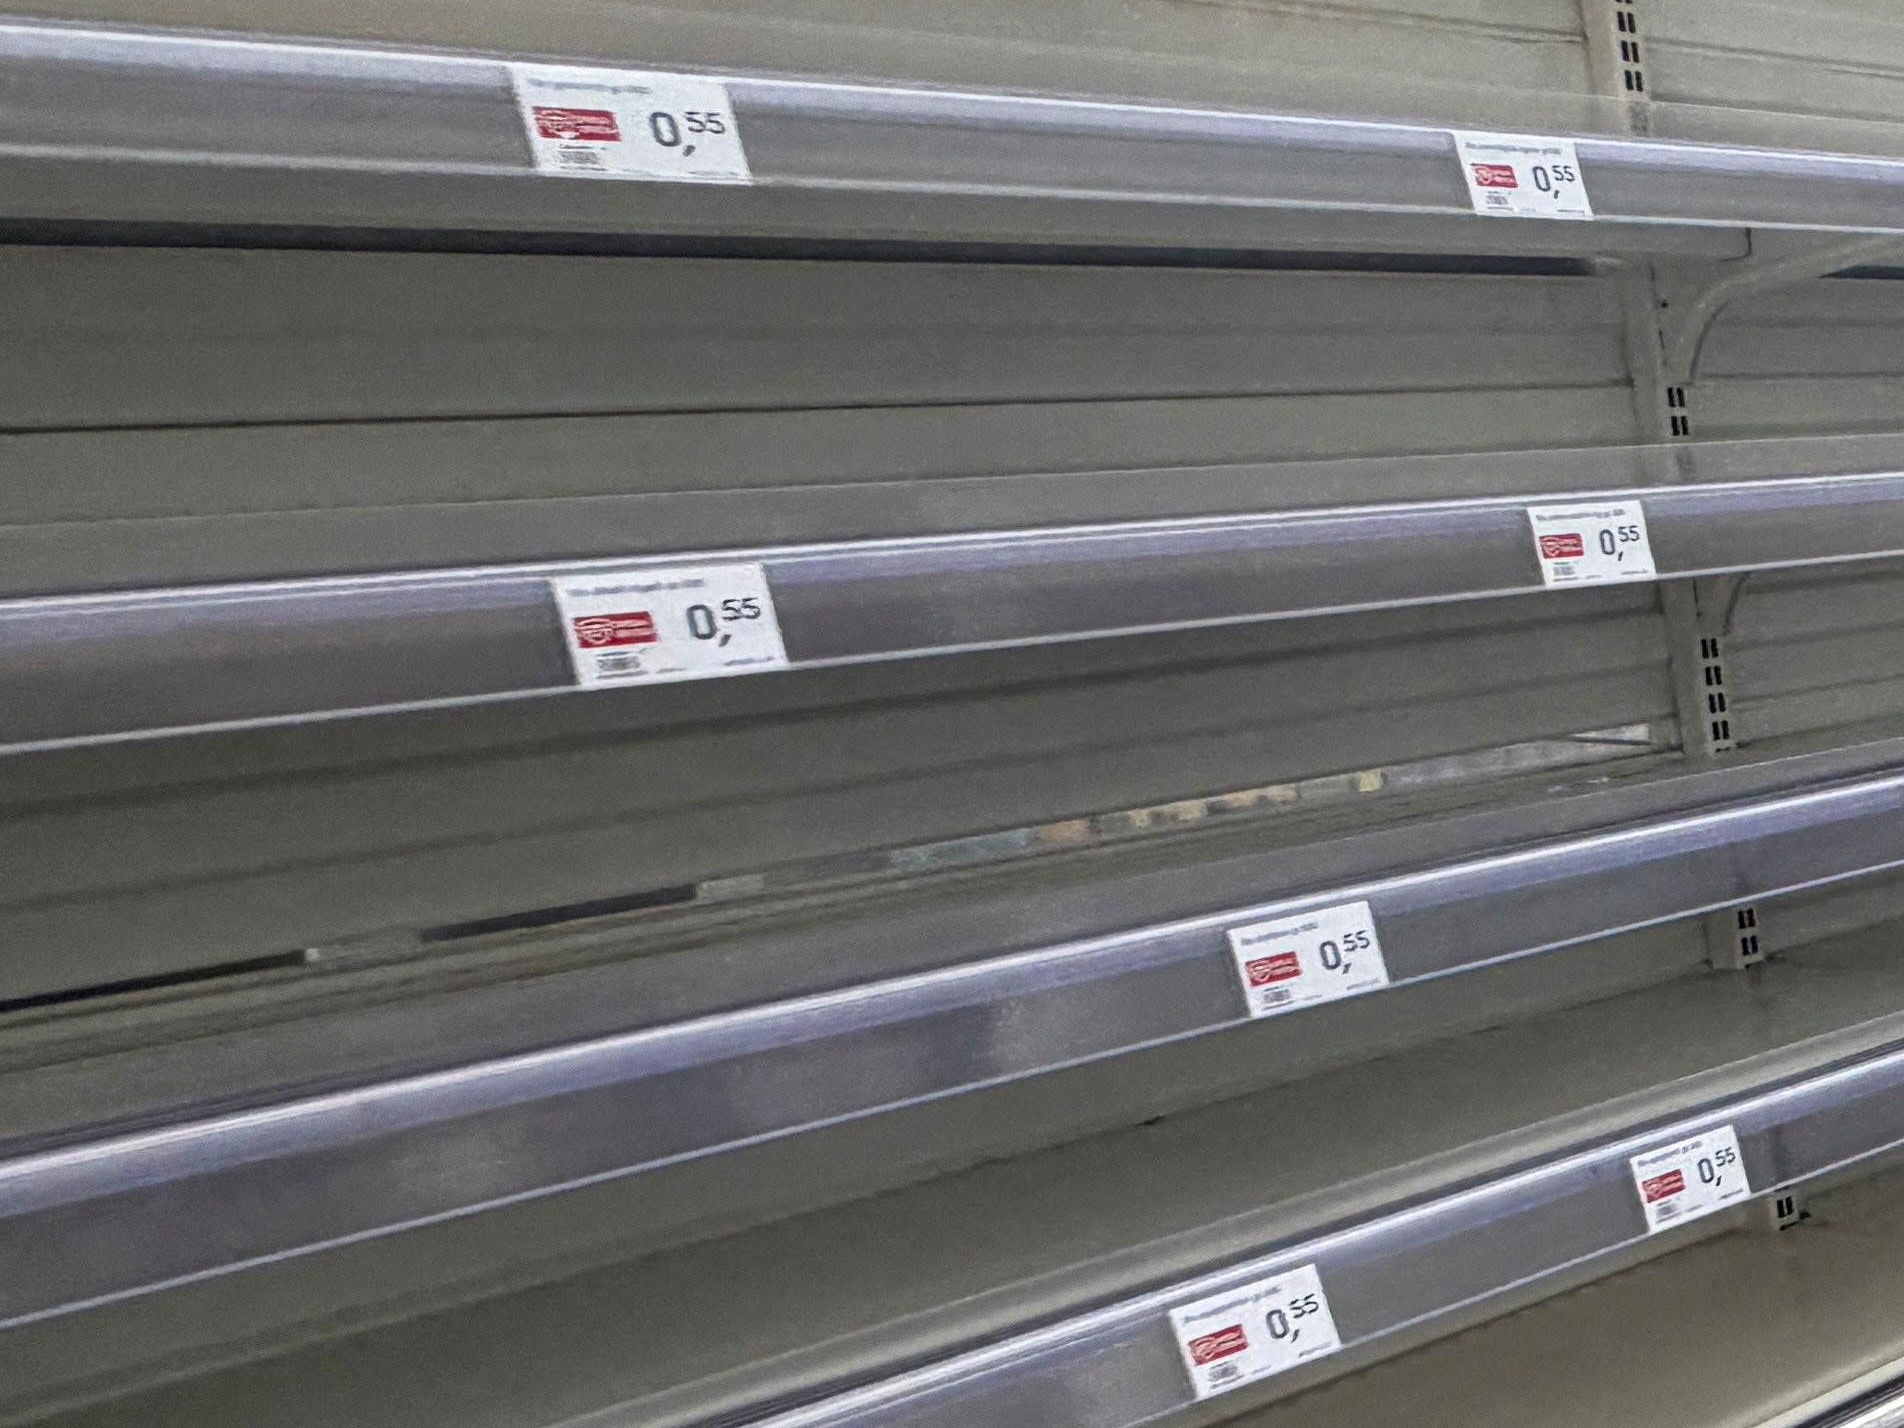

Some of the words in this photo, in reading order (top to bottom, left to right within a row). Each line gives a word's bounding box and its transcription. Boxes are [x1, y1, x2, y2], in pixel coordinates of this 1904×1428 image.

[649, 110, 727, 157] 0,55
[1532, 165, 1577, 200] 0,55
[1599, 525, 1641, 563] 0,55
[685, 596, 762, 648] 0,55
[1319, 930, 1371, 975] 0,55
[1696, 1147, 1737, 1188] 0,55
[1265, 1293, 1320, 1345] 0,55
